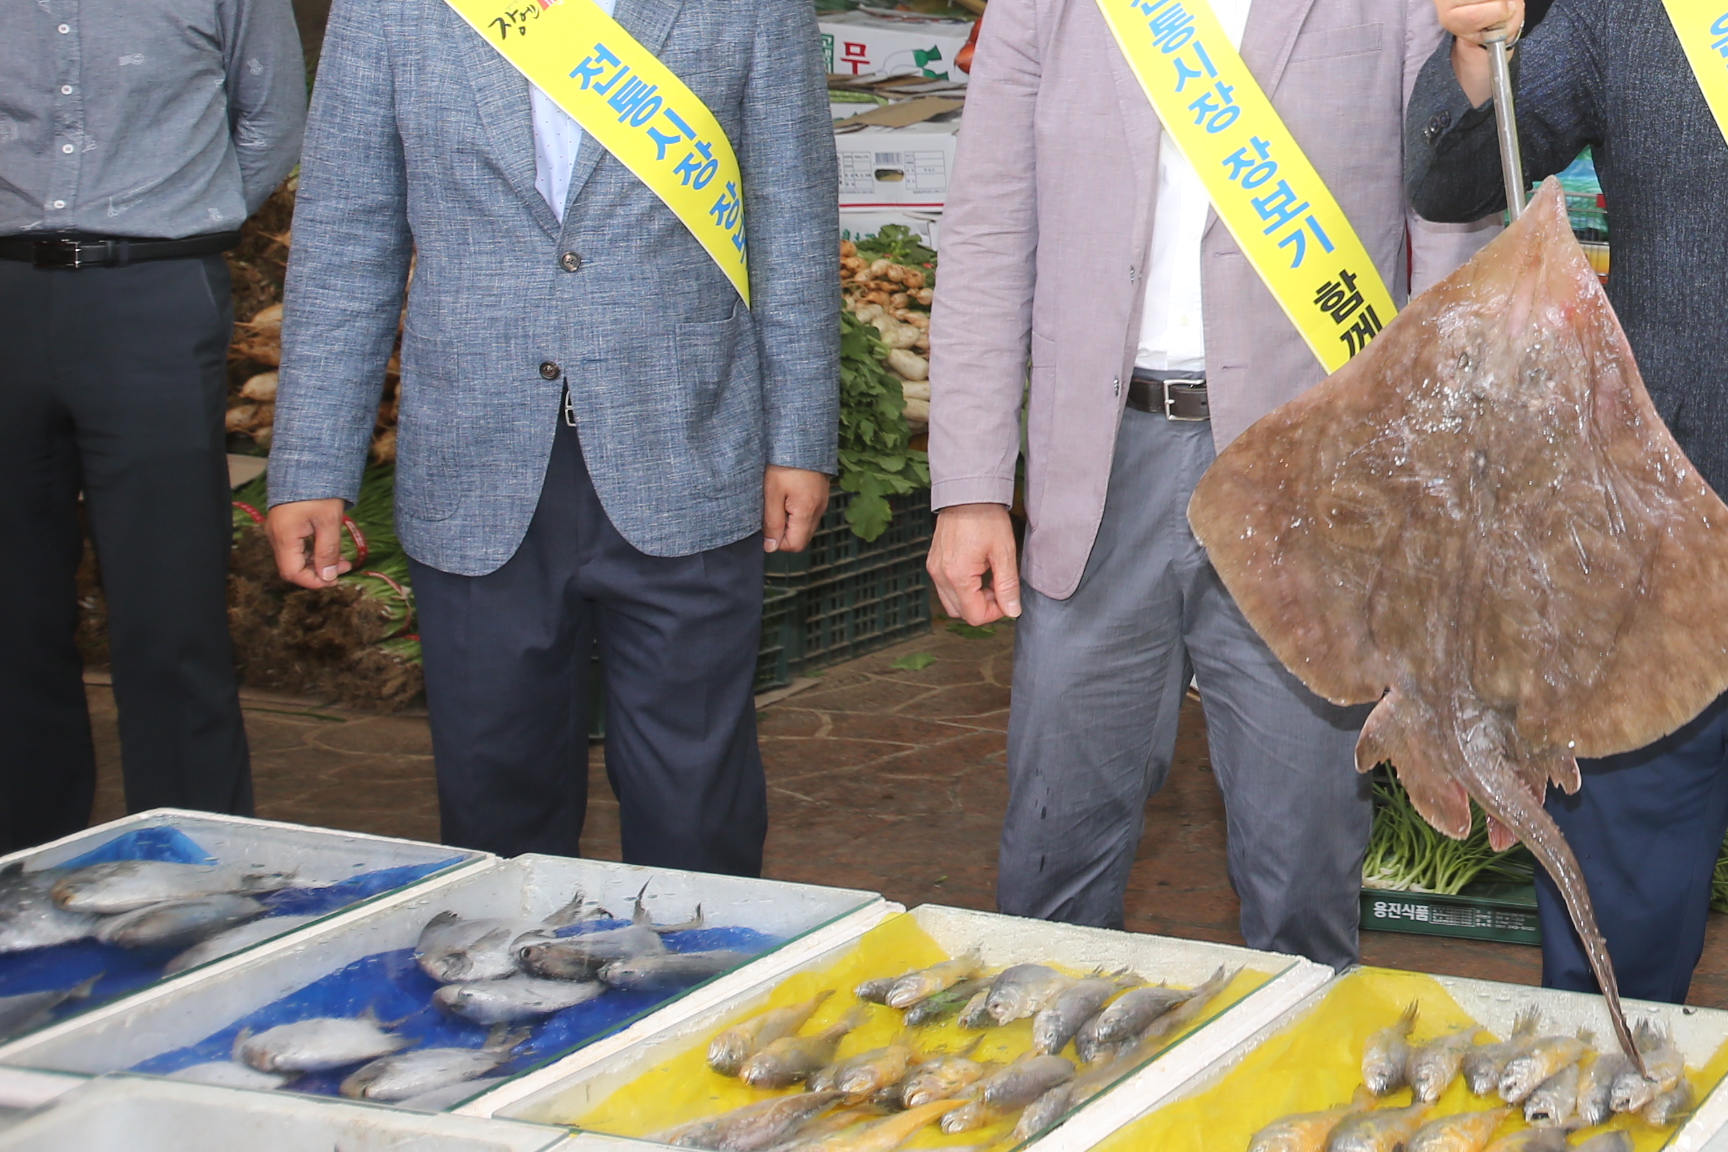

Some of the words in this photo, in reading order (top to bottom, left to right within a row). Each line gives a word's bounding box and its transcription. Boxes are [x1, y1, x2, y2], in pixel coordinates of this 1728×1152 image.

[568, 42, 719, 190] 전통시장
[1221, 135, 1335, 269] 장보기
[1373, 901, 1429, 922] 용진식품
